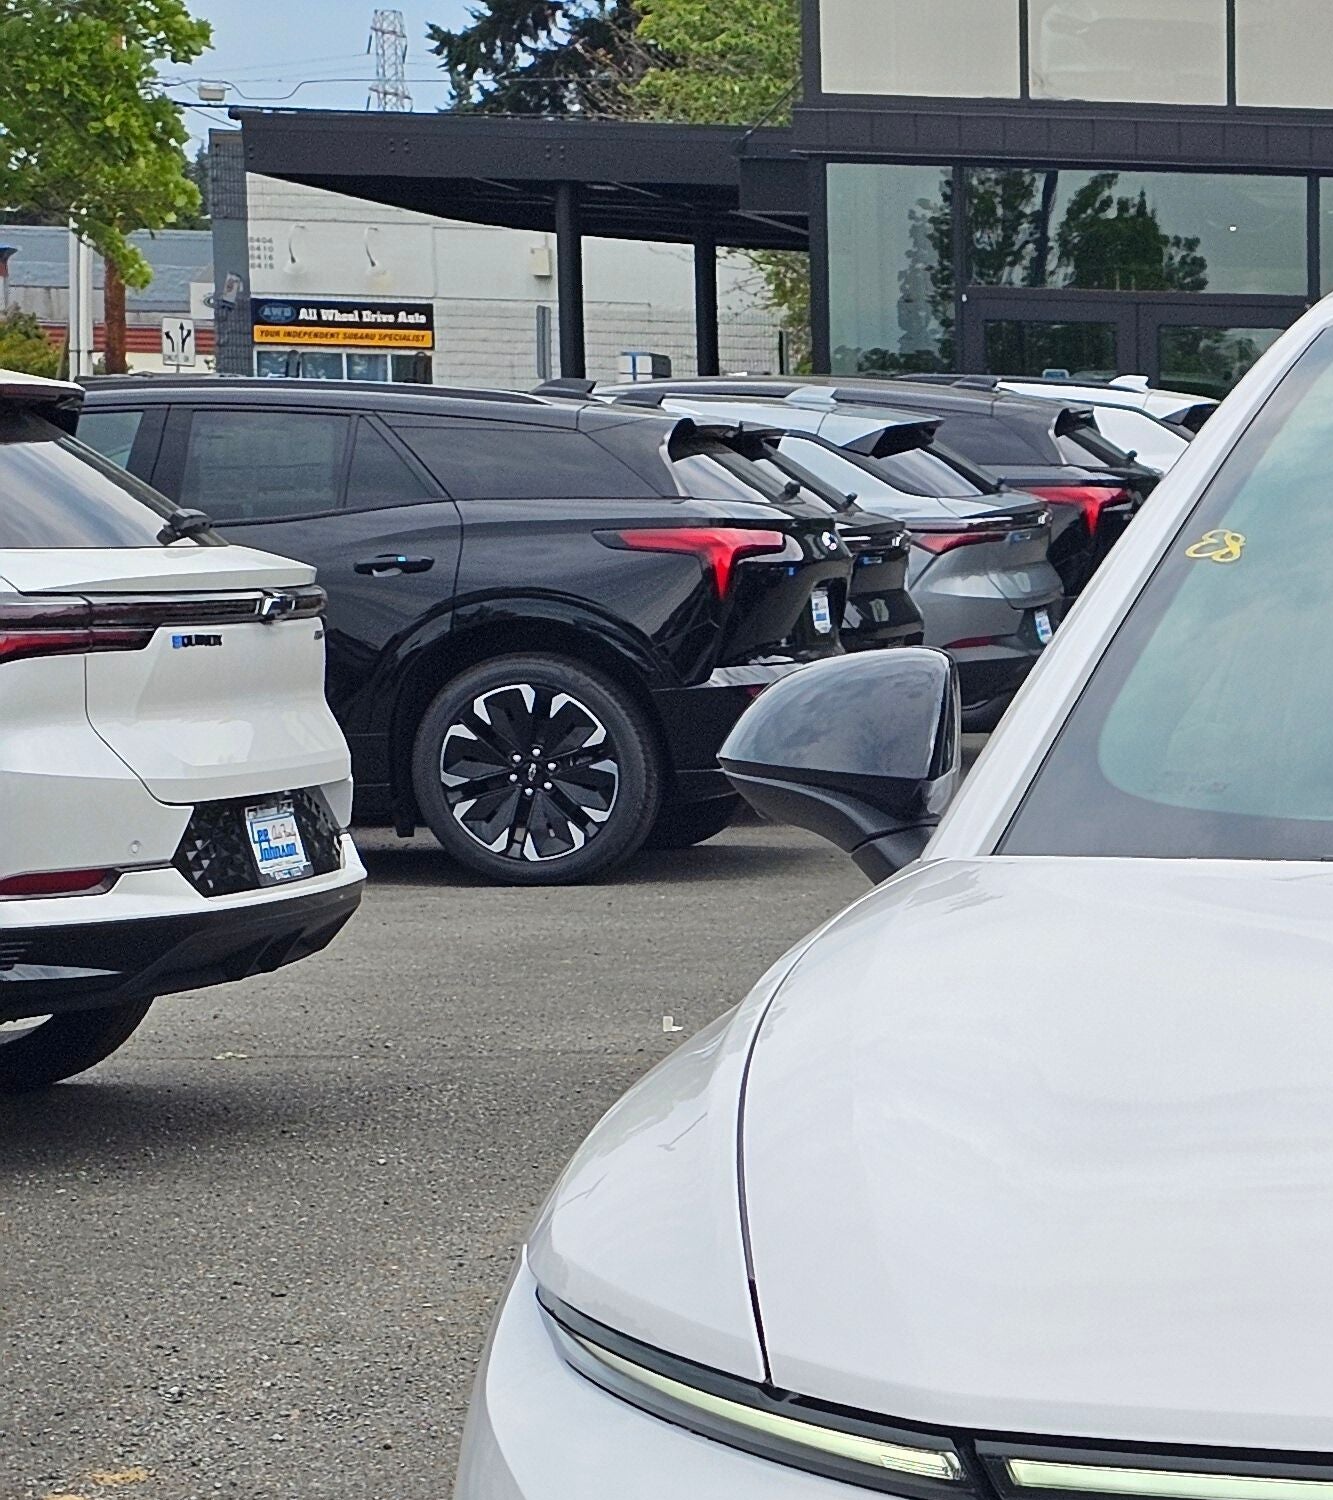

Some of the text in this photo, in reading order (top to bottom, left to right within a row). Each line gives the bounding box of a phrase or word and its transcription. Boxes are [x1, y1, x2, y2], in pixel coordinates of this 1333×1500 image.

[298, 307, 427, 324] All Wheel Drive Auto
[259, 329, 281, 338] YOUR
[283, 330, 340, 340] INDEPENDENT
[378, 333, 426, 343] SPECIALIST
